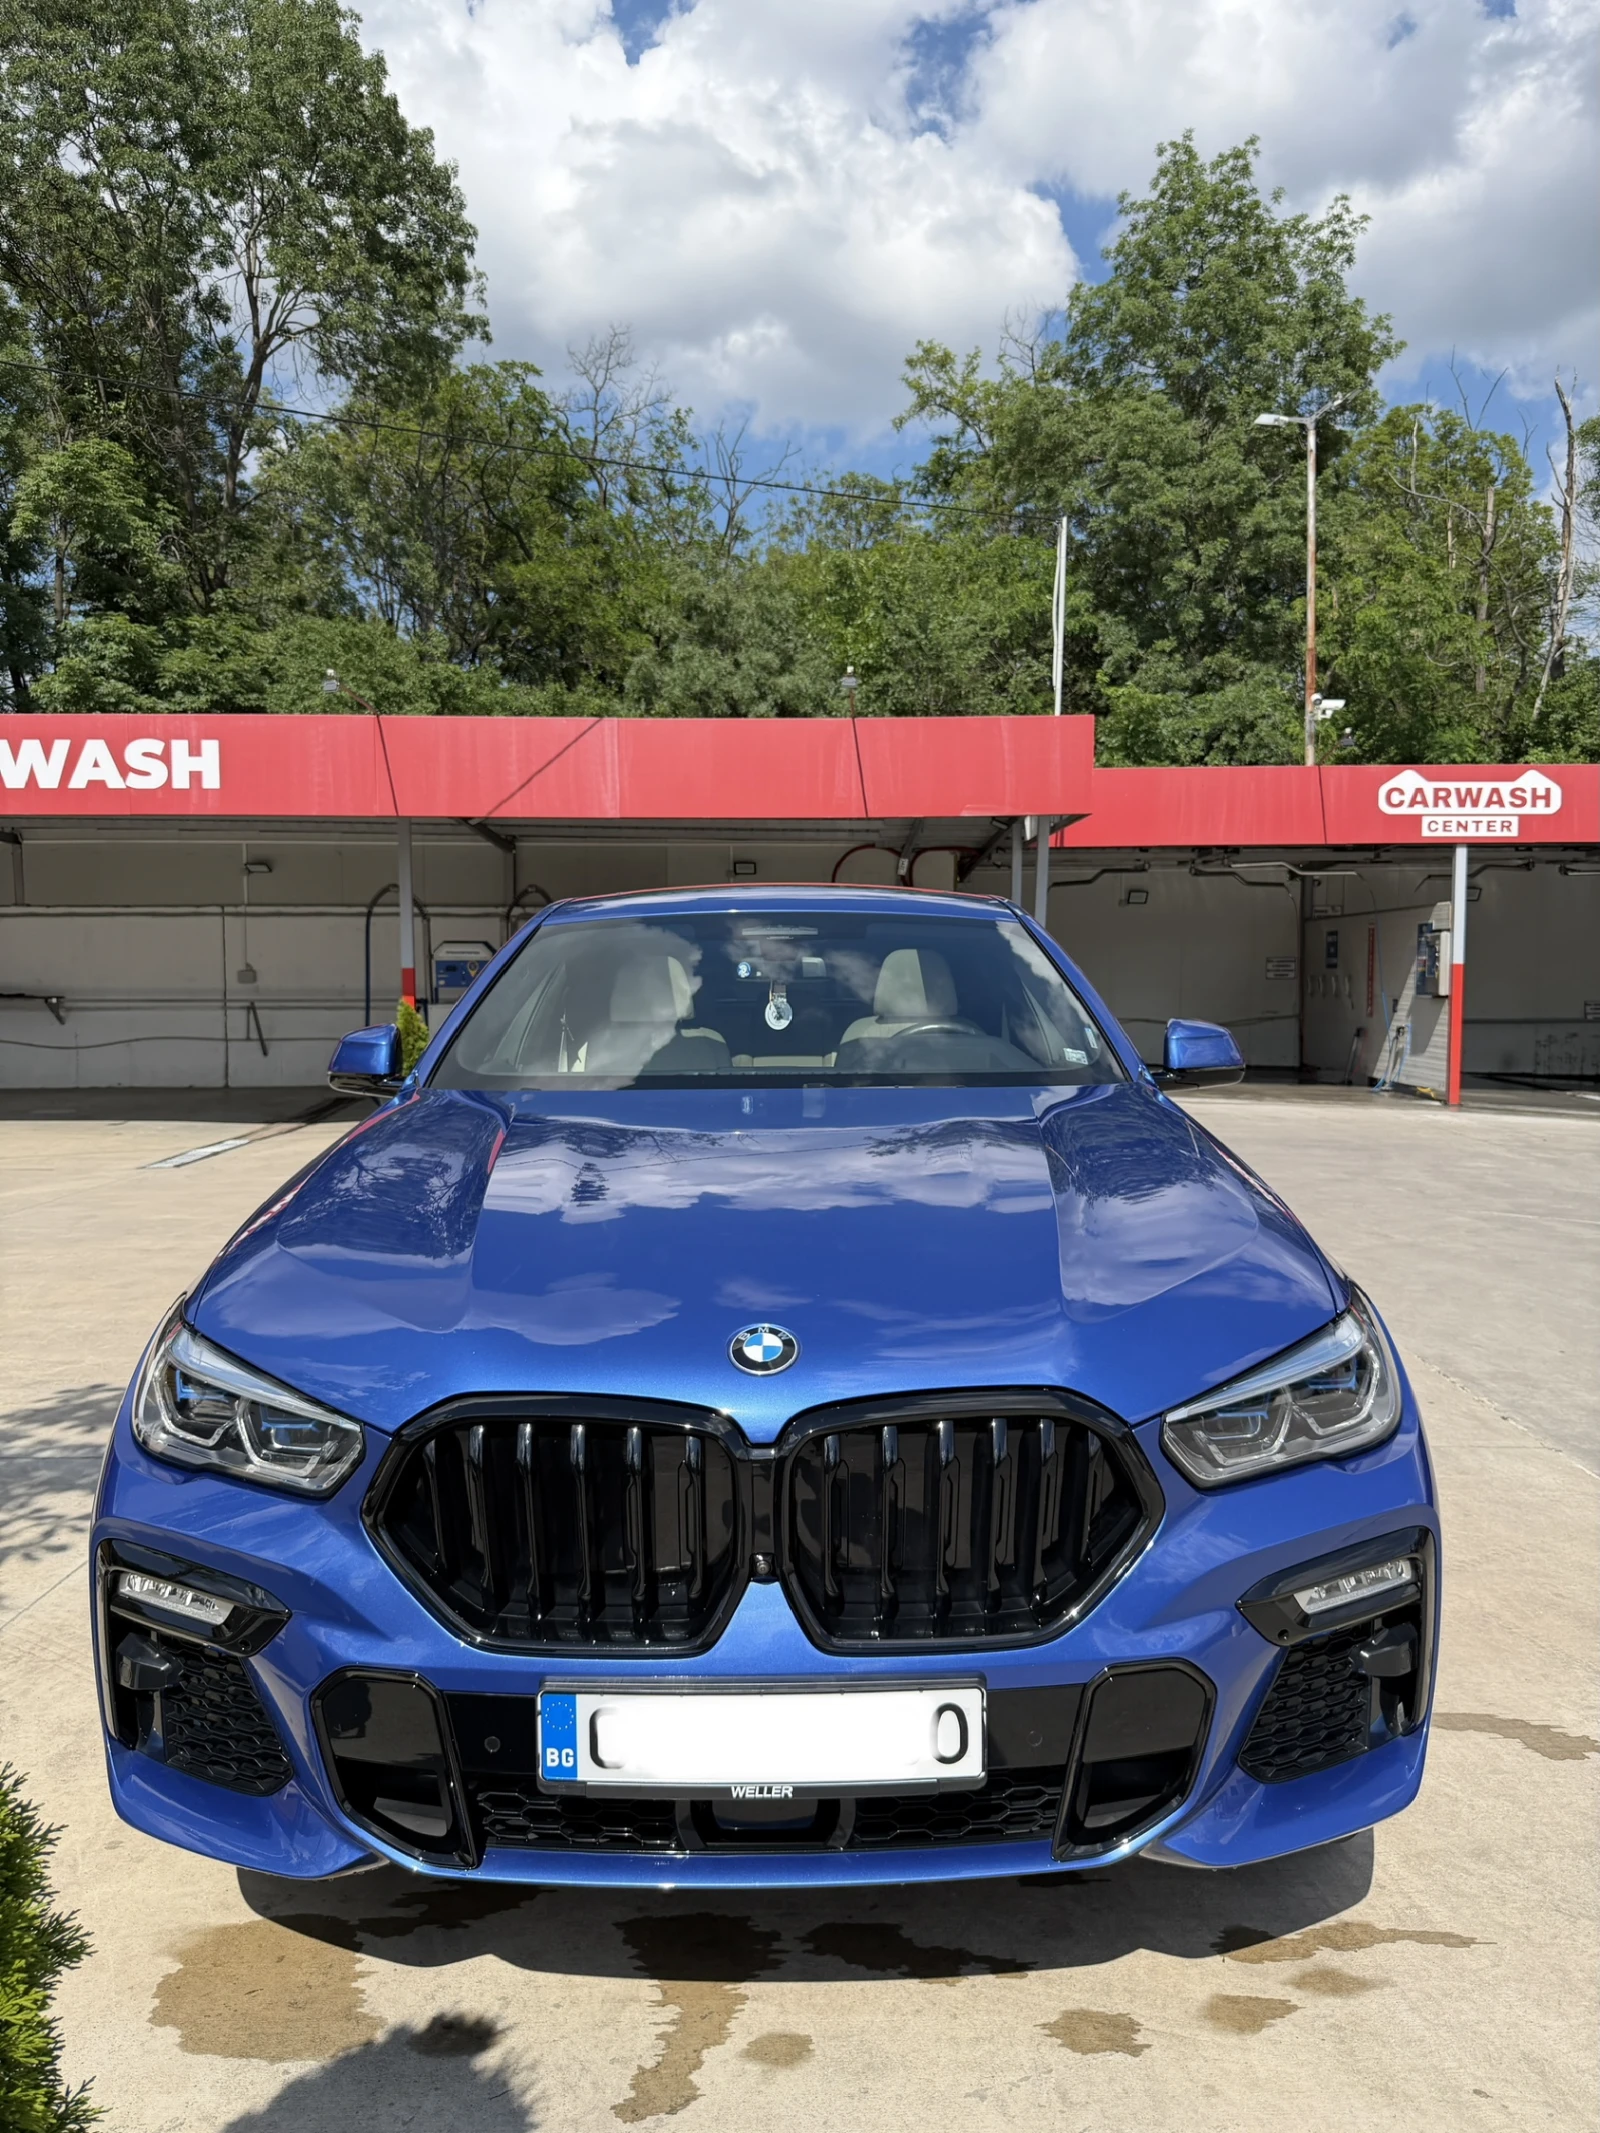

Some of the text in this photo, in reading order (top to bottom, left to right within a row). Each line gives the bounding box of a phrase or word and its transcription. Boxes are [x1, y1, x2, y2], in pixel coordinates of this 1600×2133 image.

[0, 738, 221, 790] WASH
[1384, 787, 1552, 809] CARWASH
[1427, 820, 1513, 833] CENTER
[738, 1327, 790, 1341] BMW
[546, 1747, 575, 1768] BG
[731, 1785, 794, 1799] WELLER
